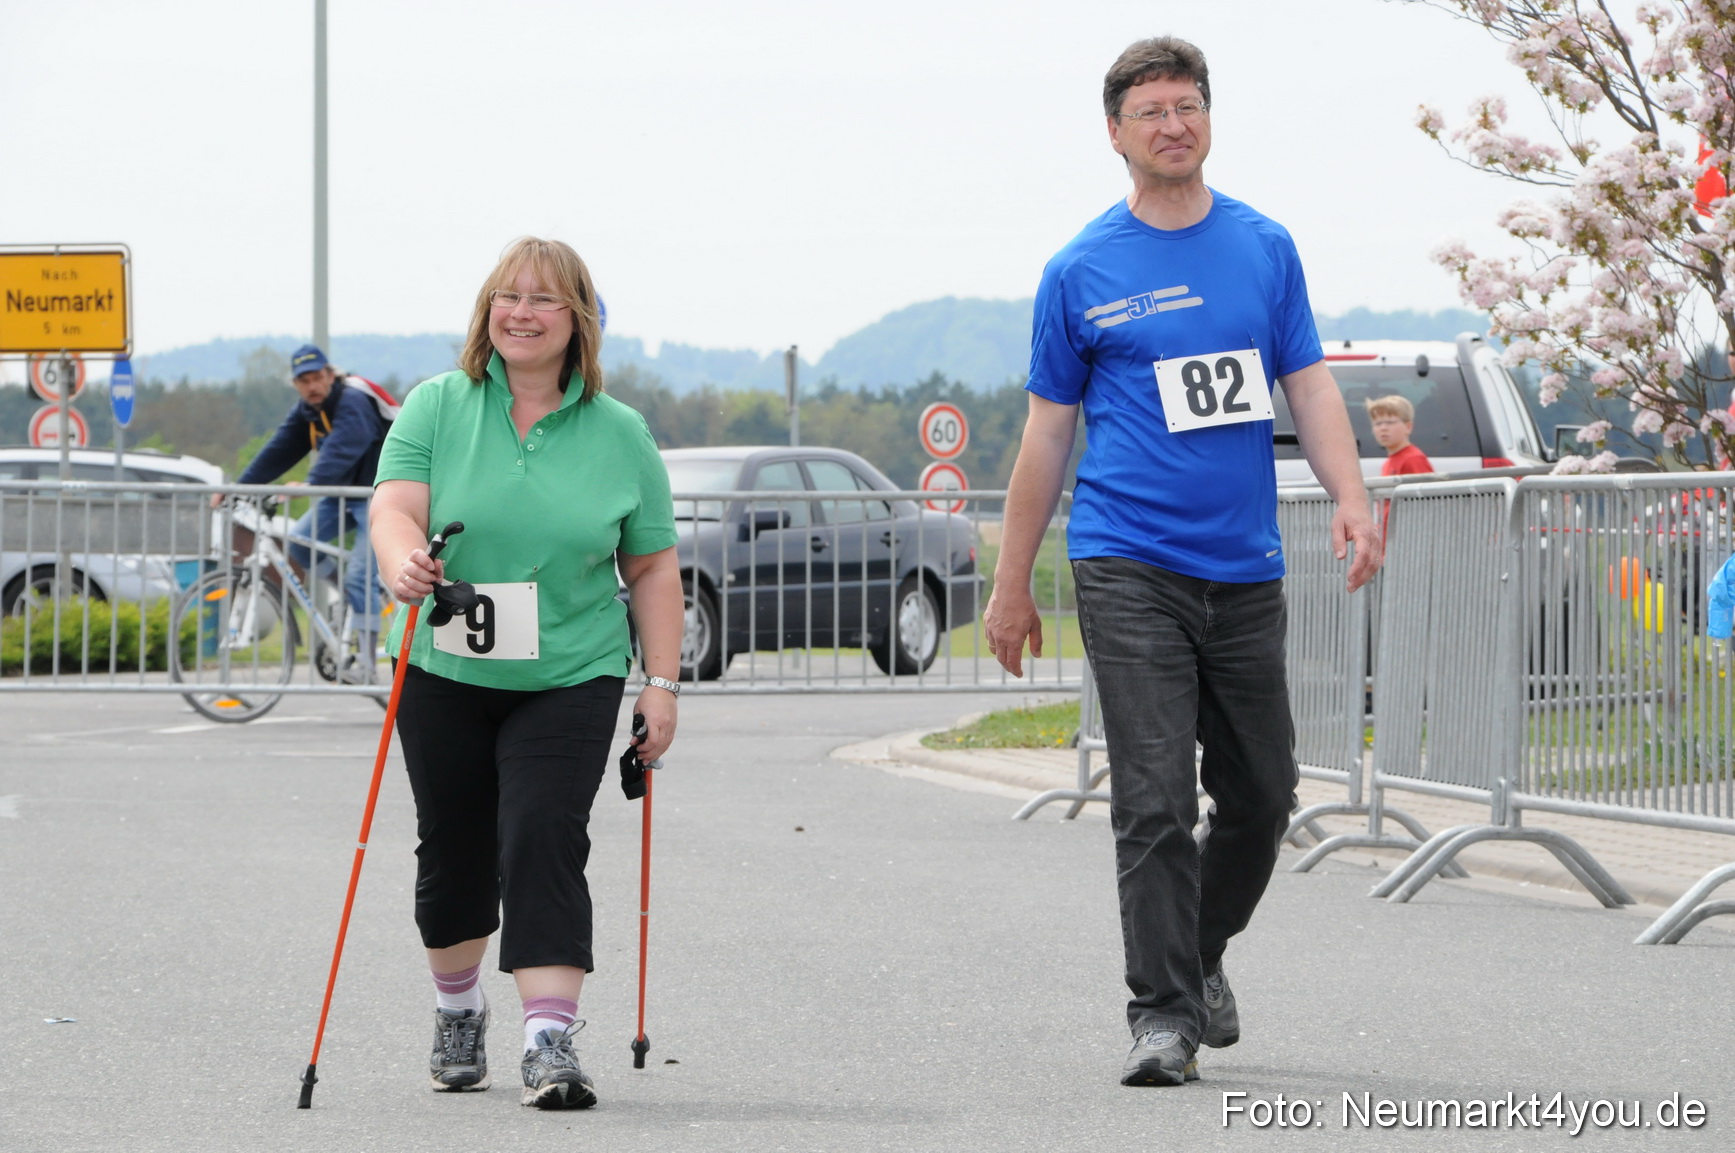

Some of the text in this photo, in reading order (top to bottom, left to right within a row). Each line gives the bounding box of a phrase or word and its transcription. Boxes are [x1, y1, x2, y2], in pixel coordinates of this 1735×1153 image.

[41, 268, 78, 280] Nach
[6, 288, 114, 312] Neumarkt
[43, 321, 81, 335] 5 km
[44, 358, 60, 385] 6
[1181, 357, 1251, 417] 82
[932, 420, 957, 443] 60
[466, 594, 495, 654] 9
